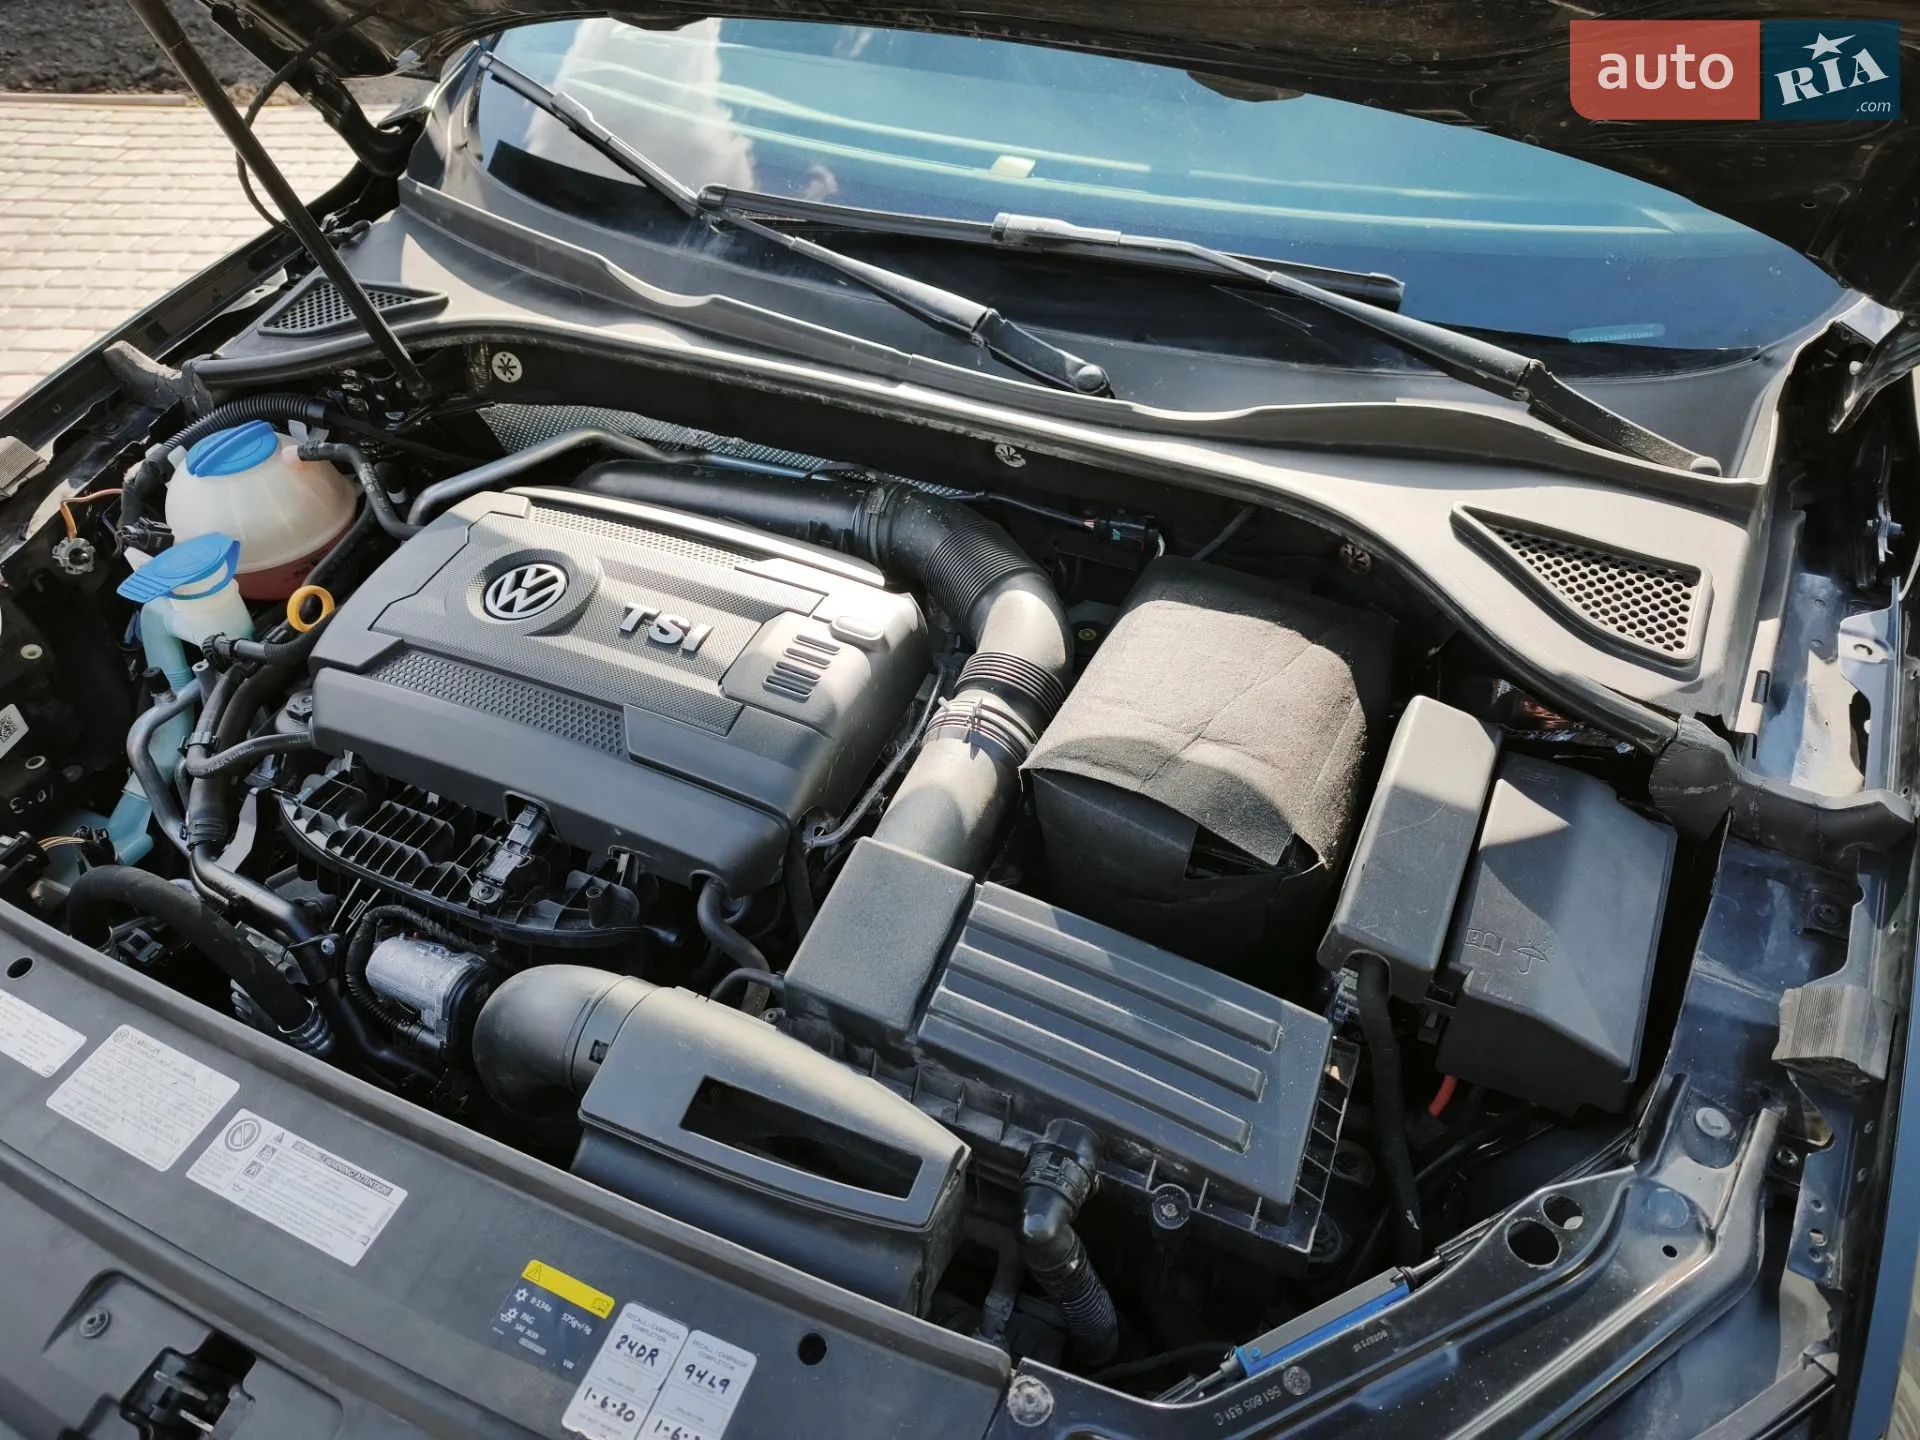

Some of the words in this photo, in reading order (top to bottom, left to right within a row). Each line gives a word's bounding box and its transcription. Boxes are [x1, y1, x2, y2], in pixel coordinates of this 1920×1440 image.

[620, 602, 713, 652] TSI
[519, 1312, 536, 1325] PAG
[684, 1363, 730, 1395] 94L9
